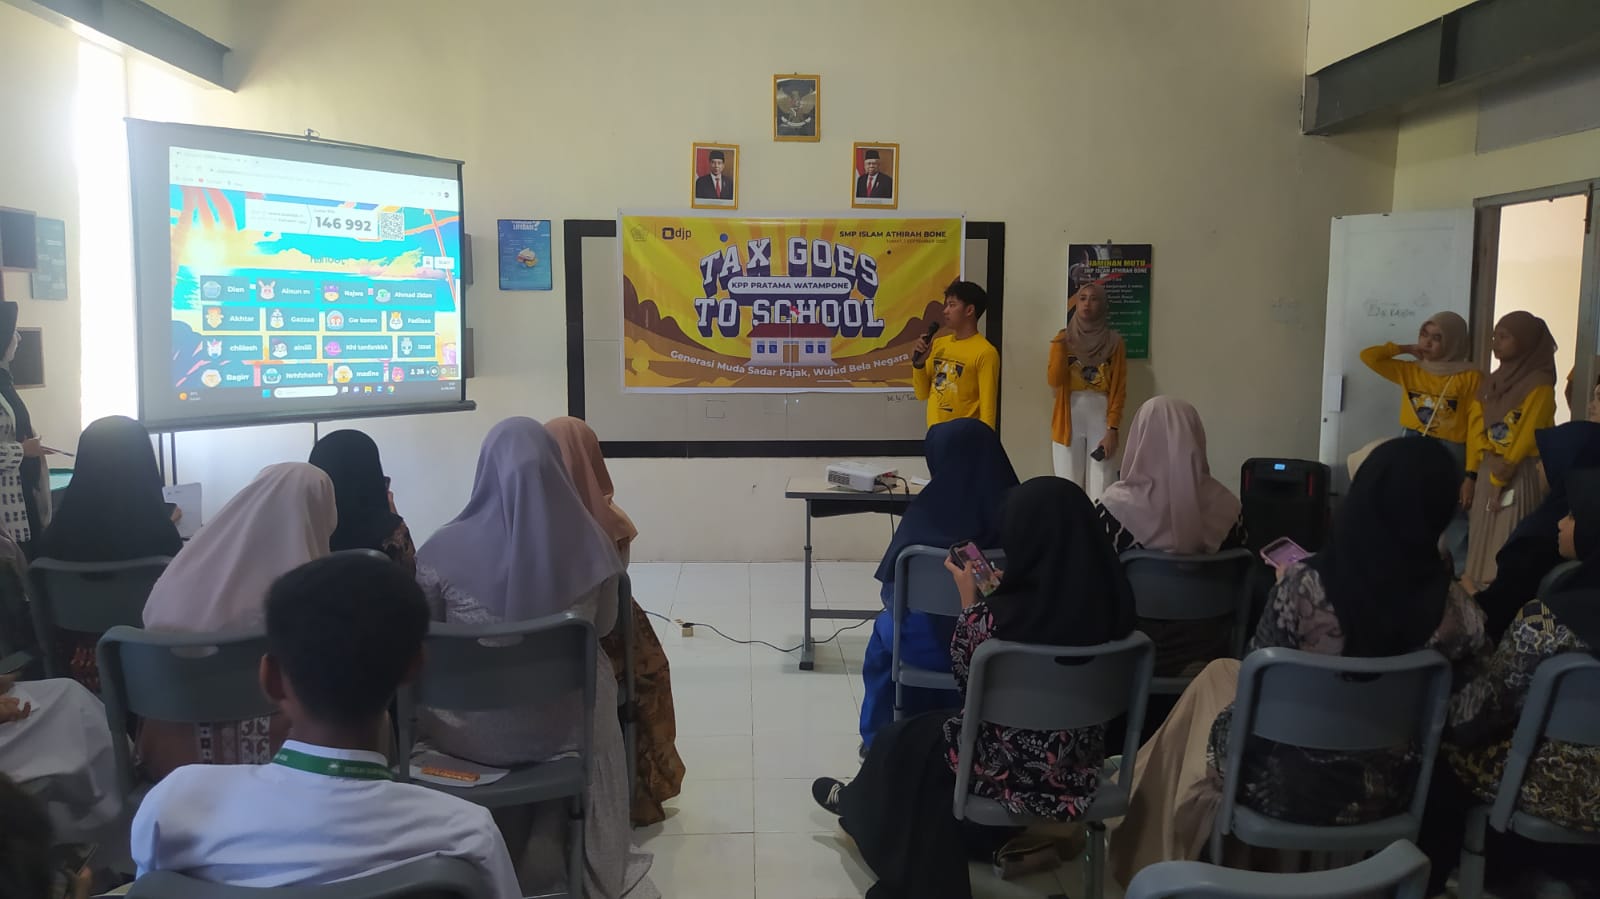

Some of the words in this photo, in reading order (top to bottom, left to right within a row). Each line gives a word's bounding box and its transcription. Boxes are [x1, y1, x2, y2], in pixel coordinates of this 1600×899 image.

[315, 216, 342, 229] 146
[345, 218, 372, 231] 992
[675, 227, 692, 240] djp
[839, 230, 857, 238] SMP
[859, 230, 883, 238] ISLAM
[885, 230, 922, 238] ATHIRAH
[923, 230, 947, 238] BONE
[700, 238, 771, 291] TAX
[787, 236, 880, 292] GOES
[731, 281, 749, 290] KPP
[750, 281, 792, 290] PRATAMA
[794, 281, 850, 290] WATAMPONE
[694, 297, 740, 334] TO
[752, 298, 886, 334] SCHOOL
[670, 350, 715, 368] Generasi
[717, 362, 745, 374] Muda
[748, 366, 776, 377] Sadar
[780, 368, 811, 378] Pajak,
[813, 366, 847, 377] Wujud
[849, 362, 872, 373] Bela
[873, 353, 910, 368] Negara
